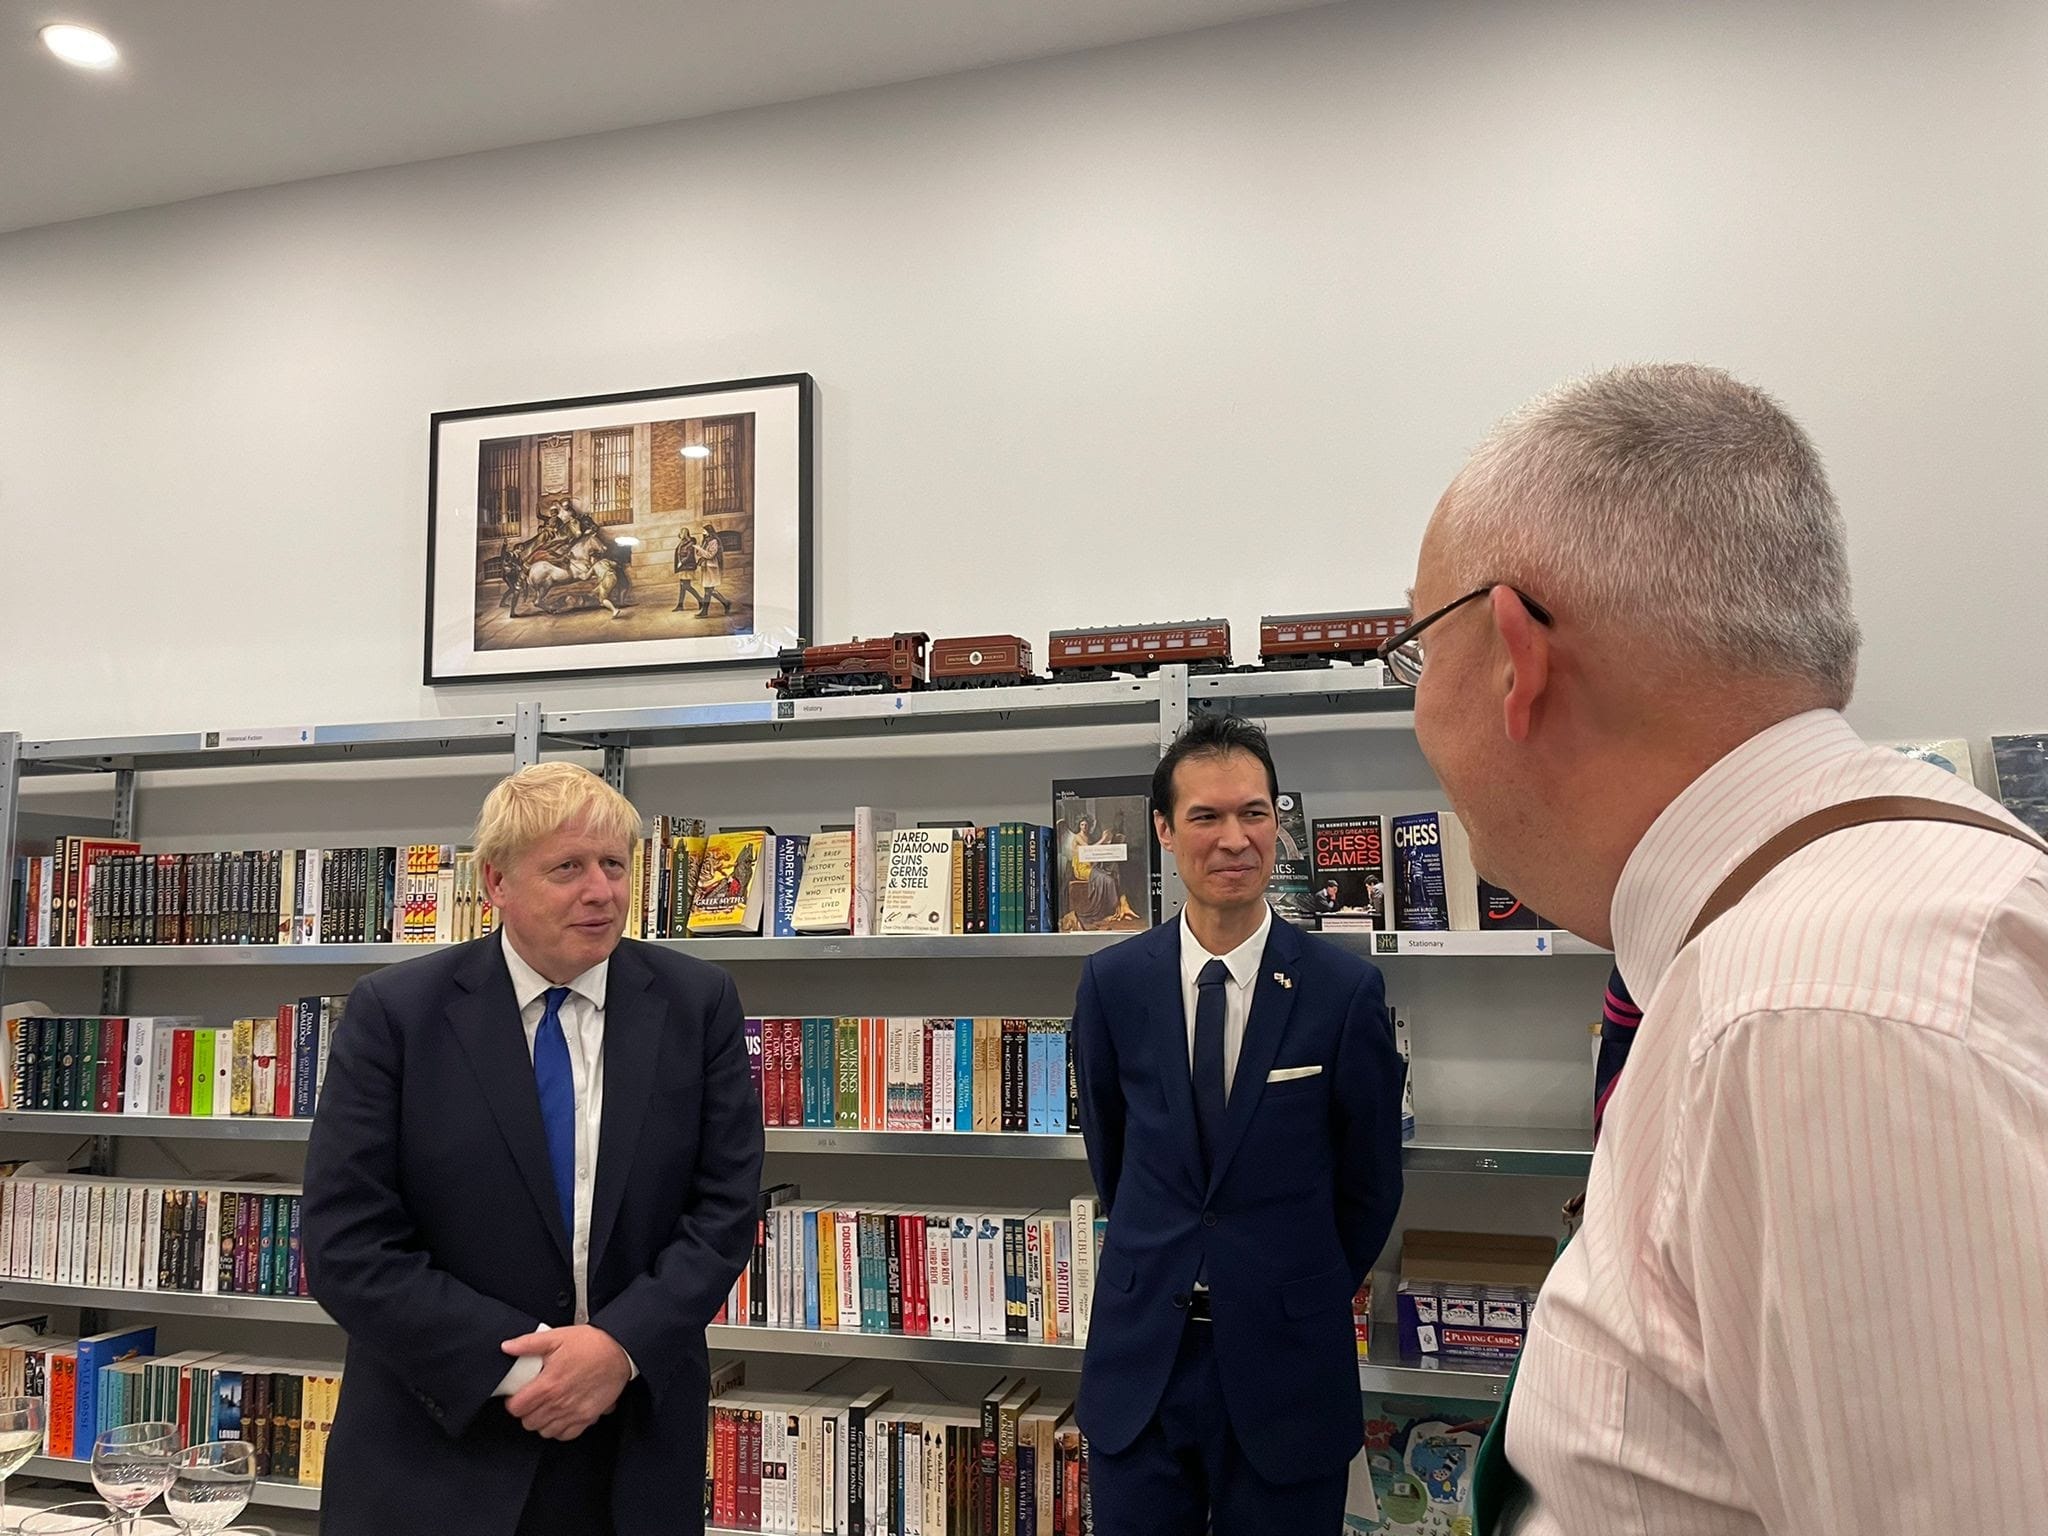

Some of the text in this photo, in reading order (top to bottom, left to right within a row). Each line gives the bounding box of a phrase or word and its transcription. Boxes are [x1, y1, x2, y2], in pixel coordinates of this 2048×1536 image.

[893, 843, 949, 853] DIAMOND
[894, 832, 929, 843] JARED
[1316, 835, 1380, 851] CHESS
[1395, 823, 1438, 848] CHESS
[55, 839, 64, 869] HITLER'S
[892, 855, 922, 865] GUNS
[1317, 850, 1380, 866] GAMES
[785, 838, 794, 920] ANDREW MARR
[813, 875, 845, 883] EVERYONE
[889, 878, 928, 888] & STEEL
[890, 866, 928, 877] GERMS
[260, 886, 268, 913] Cornwell
[322, 914, 330, 934] 1356
[1409, 940, 1443, 948] Stationary
[299, 1002, 307, 1045] GABALDON
[764, 1023, 773, 1070] HOLLAND
[784, 1023, 793, 1070] HOLLAND
[912, 1029, 921, 1073] Millennium
[305, 1057, 309, 1065] GO
[840, 1049, 848, 1093] VIKINGS
[849, 1049, 857, 1093] VIKINGS
[1027, 1225, 1038, 1252] SAS
[1077, 1204, 1087, 1265] CRUCIBLE
[842, 1226, 851, 1271] COLOSSUS
[889, 1257, 899, 1293] DEATH
[929, 1247, 938, 1284] THIRD REICH
[941, 1248, 950, 1285] THIRD REICH
[1057, 1260, 1069, 1313] PARTITION
[1451, 1334, 1514, 1344] PLAYING CARDS
[752, 1436, 761, 1460] HENRY
[984, 1477, 992, 1533] REVOLUTION
